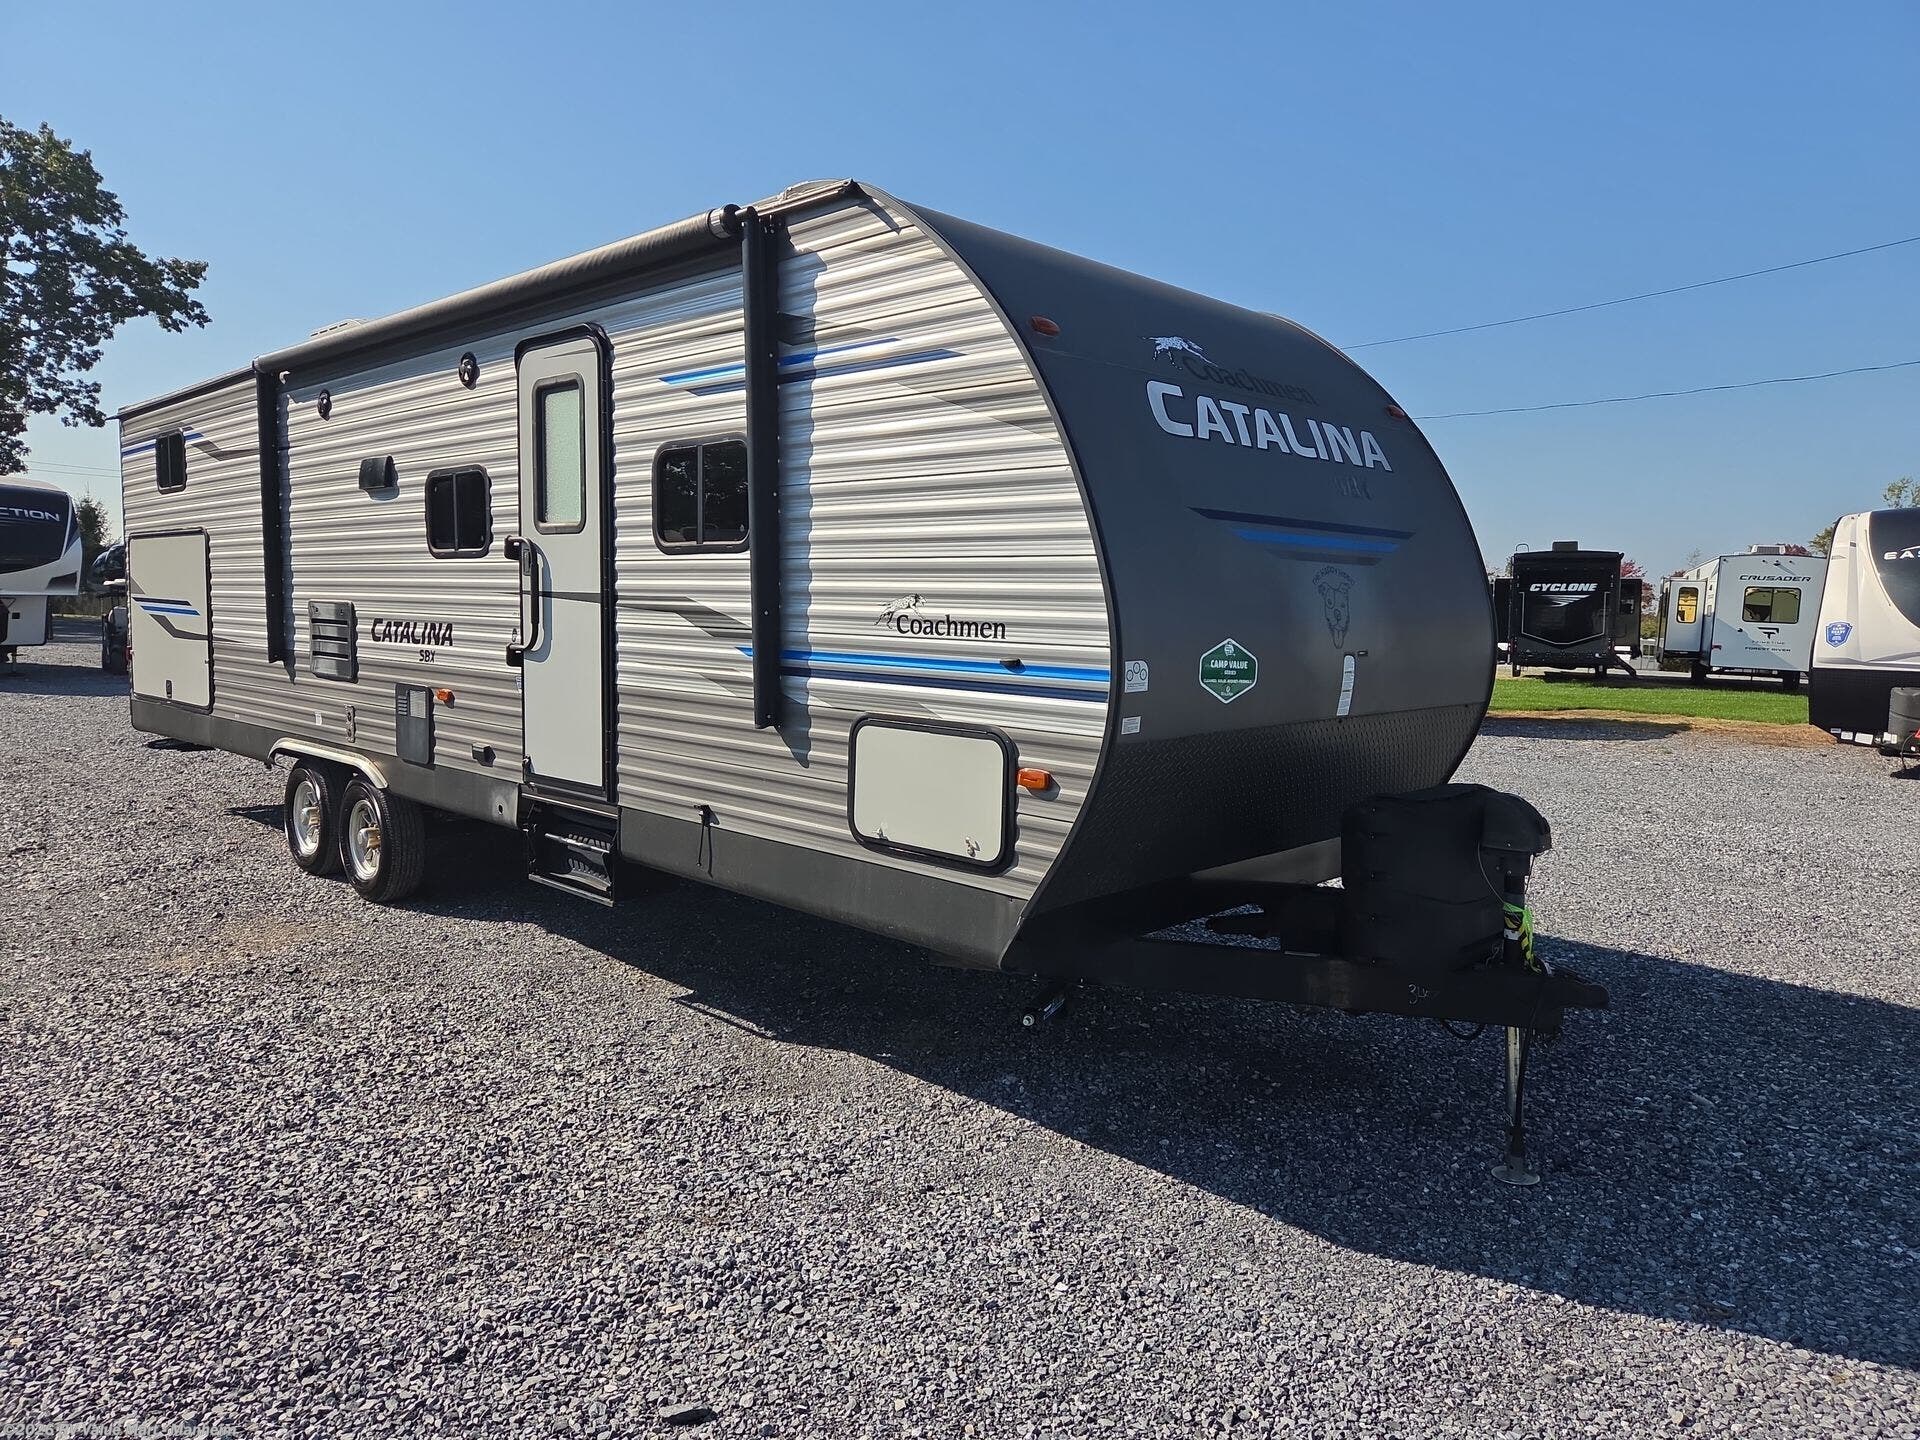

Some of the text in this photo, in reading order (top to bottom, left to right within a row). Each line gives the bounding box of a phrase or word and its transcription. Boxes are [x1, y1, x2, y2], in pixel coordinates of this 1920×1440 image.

[1182, 356, 1319, 407] Coachmen
[1146, 380, 1393, 472] CATALINA
[1884, 550, 1920, 560] EA
[1529, 583, 1598, 592] CYCLONE
[371, 618, 453, 647] CATALINA
[897, 614, 1007, 640] Coachmen
[419, 649, 436, 664] SBX
[1210, 659, 1249, 669] CAMP VALUE
